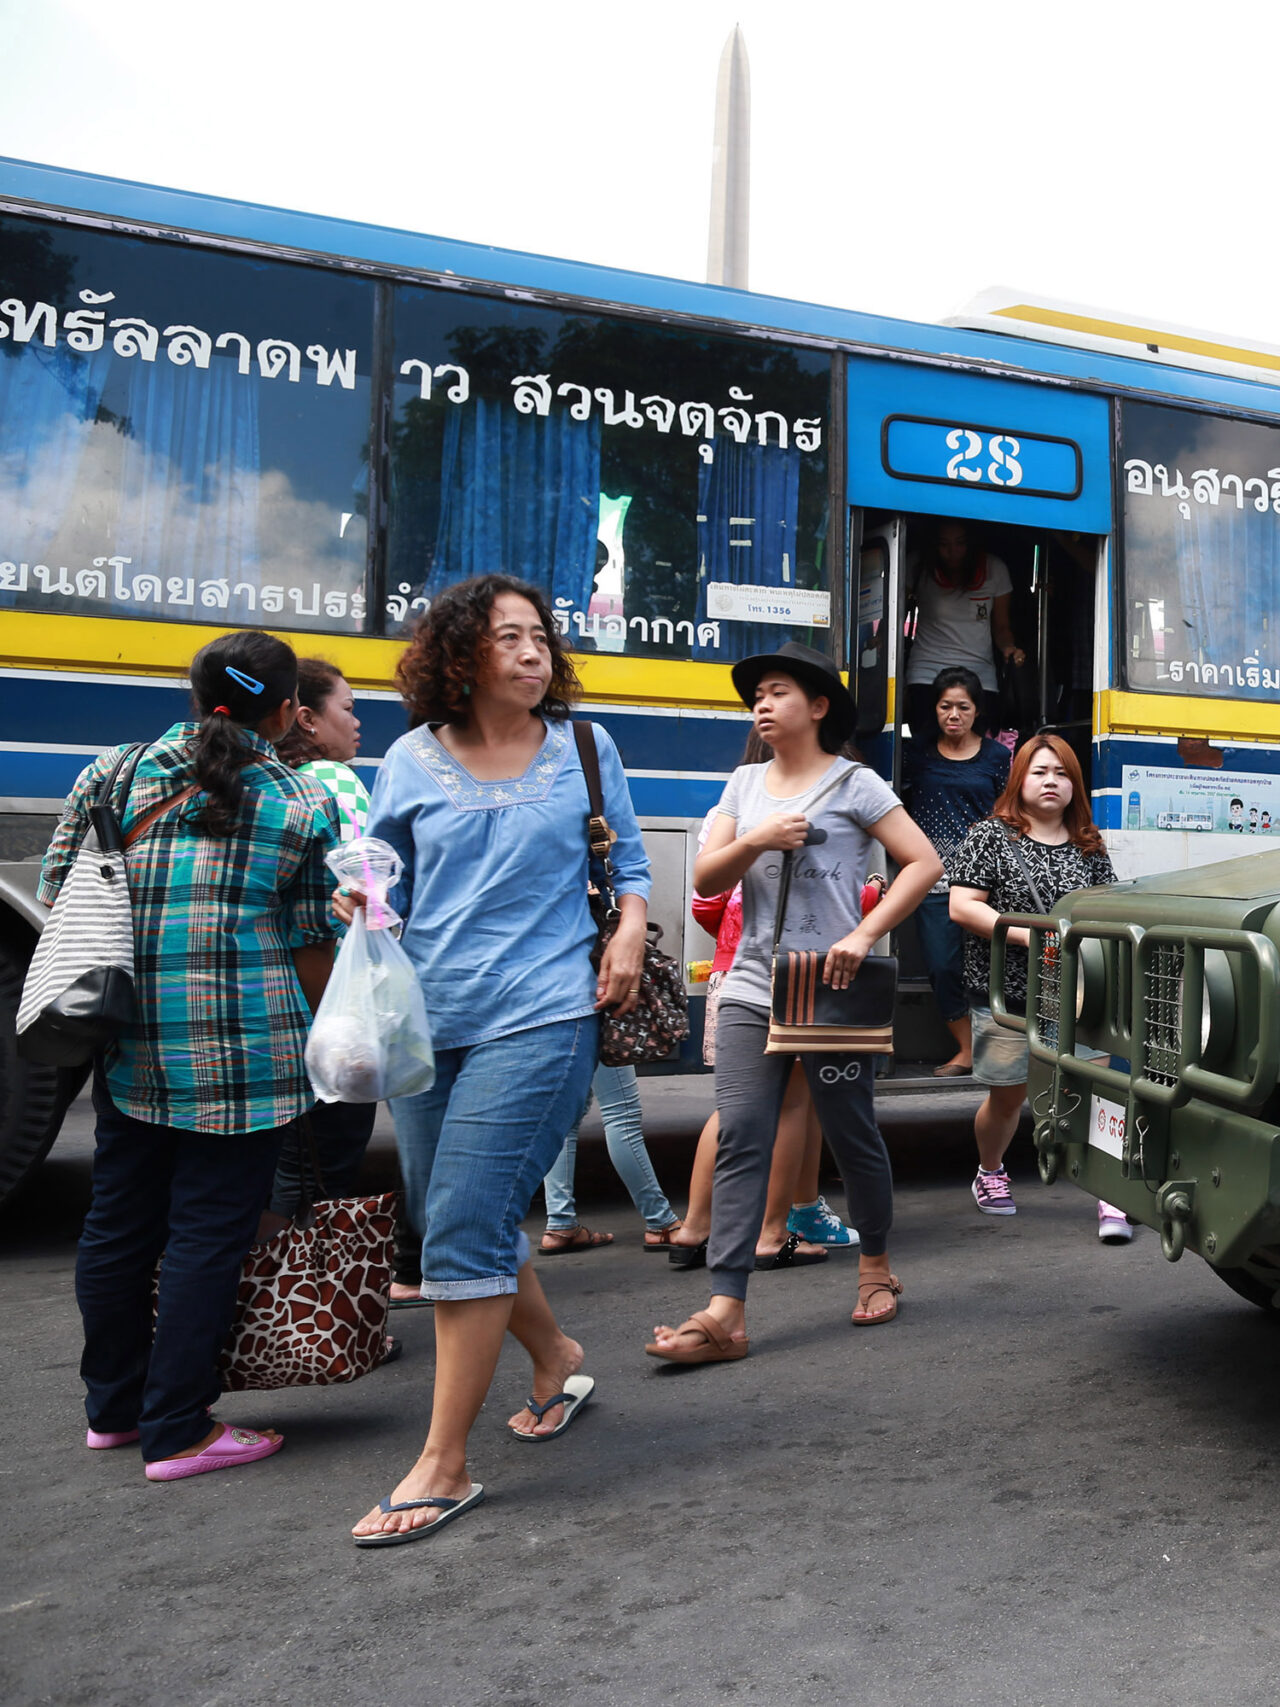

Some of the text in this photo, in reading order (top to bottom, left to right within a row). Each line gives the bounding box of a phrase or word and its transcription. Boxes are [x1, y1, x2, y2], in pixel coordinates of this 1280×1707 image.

[511, 373, 823, 464] สวนจตุจักร
[945, 428, 1023, 487] 28
[767, 605, 792, 616] 1356
